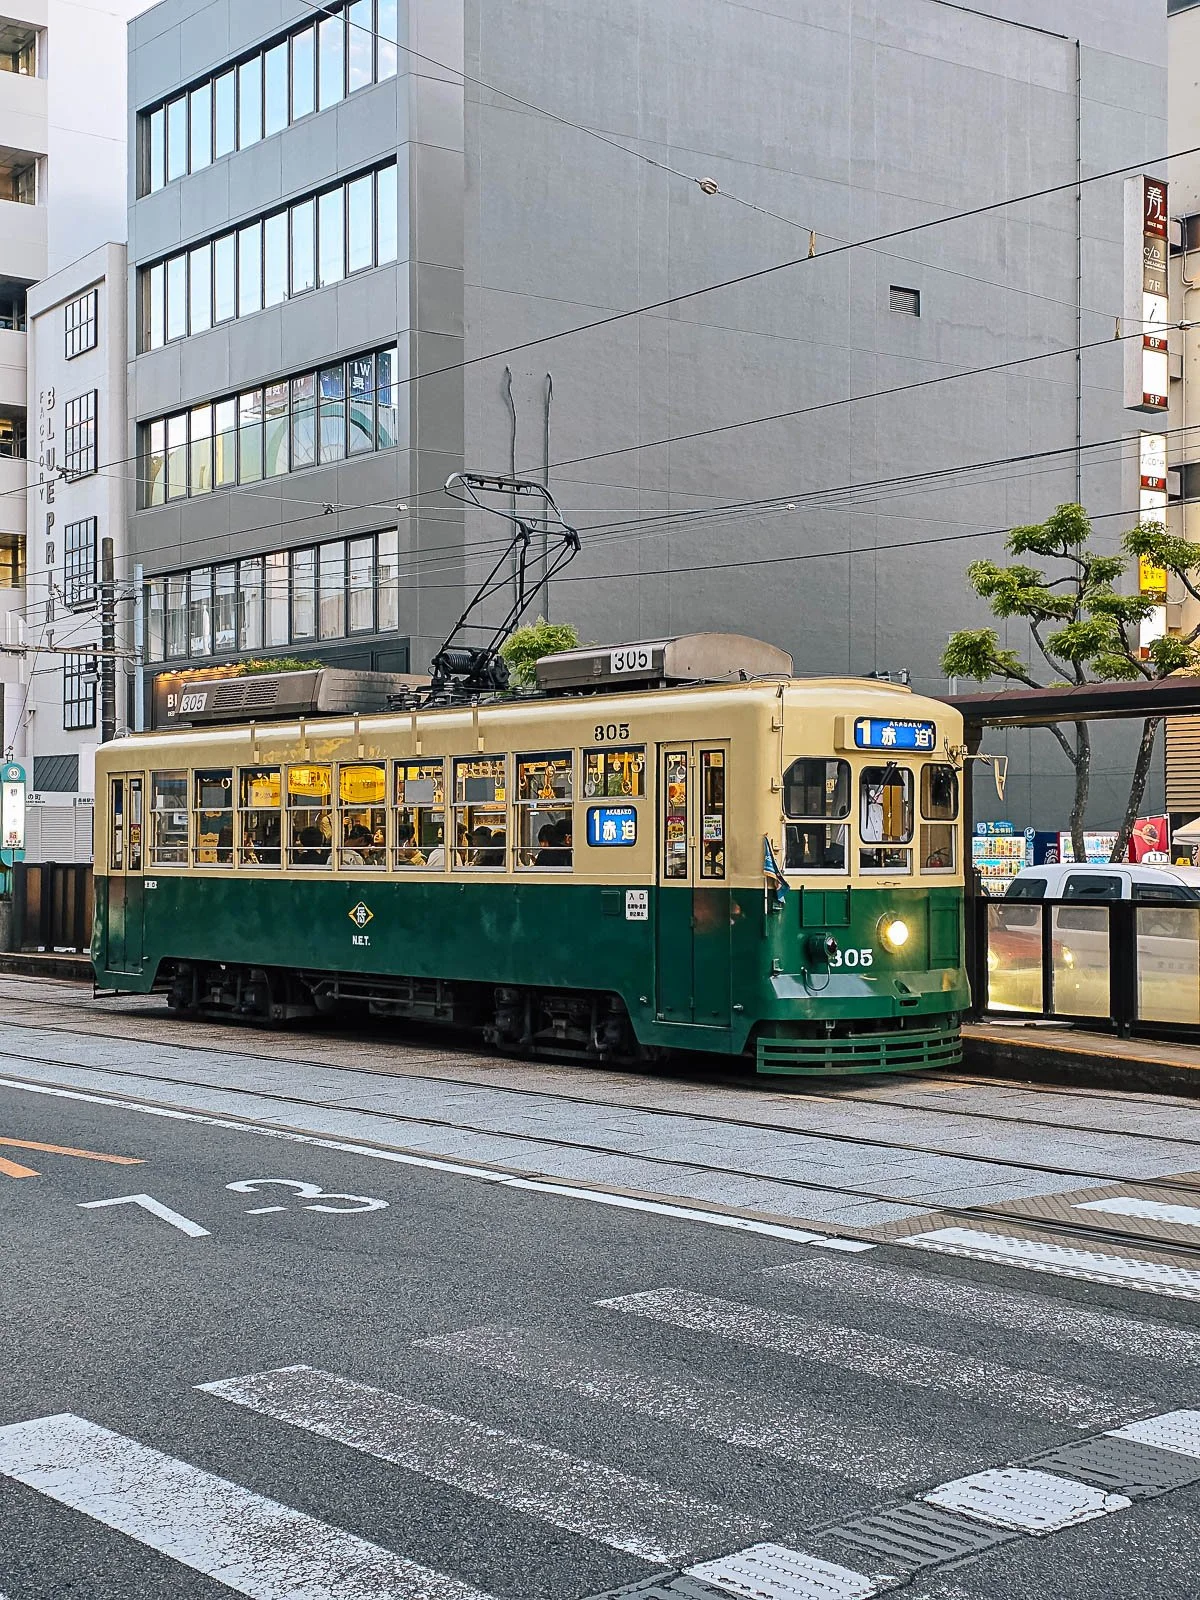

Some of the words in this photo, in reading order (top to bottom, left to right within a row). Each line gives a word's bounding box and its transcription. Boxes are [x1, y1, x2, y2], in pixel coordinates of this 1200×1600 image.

[1147, 186, 1163, 219] 寿
[1148, 279, 1161, 292] 7F
[1149, 337, 1161, 348] 6F
[1149, 394, 1161, 405] 5F
[1147, 477, 1159, 487] 4F
[46, 386, 55, 647] BLUEPRINT
[614, 649, 648, 671] 305
[182, 694, 205, 712] 305
[594, 723, 630, 741] 305
[857, 719, 871, 745] 1
[881, 726, 930, 747] 赤迫
[593, 809, 600, 841] 1
[602, 819, 636, 841] 赤迫
[629, 892, 645, 901] 入口
[829, 948, 873, 967] 305
